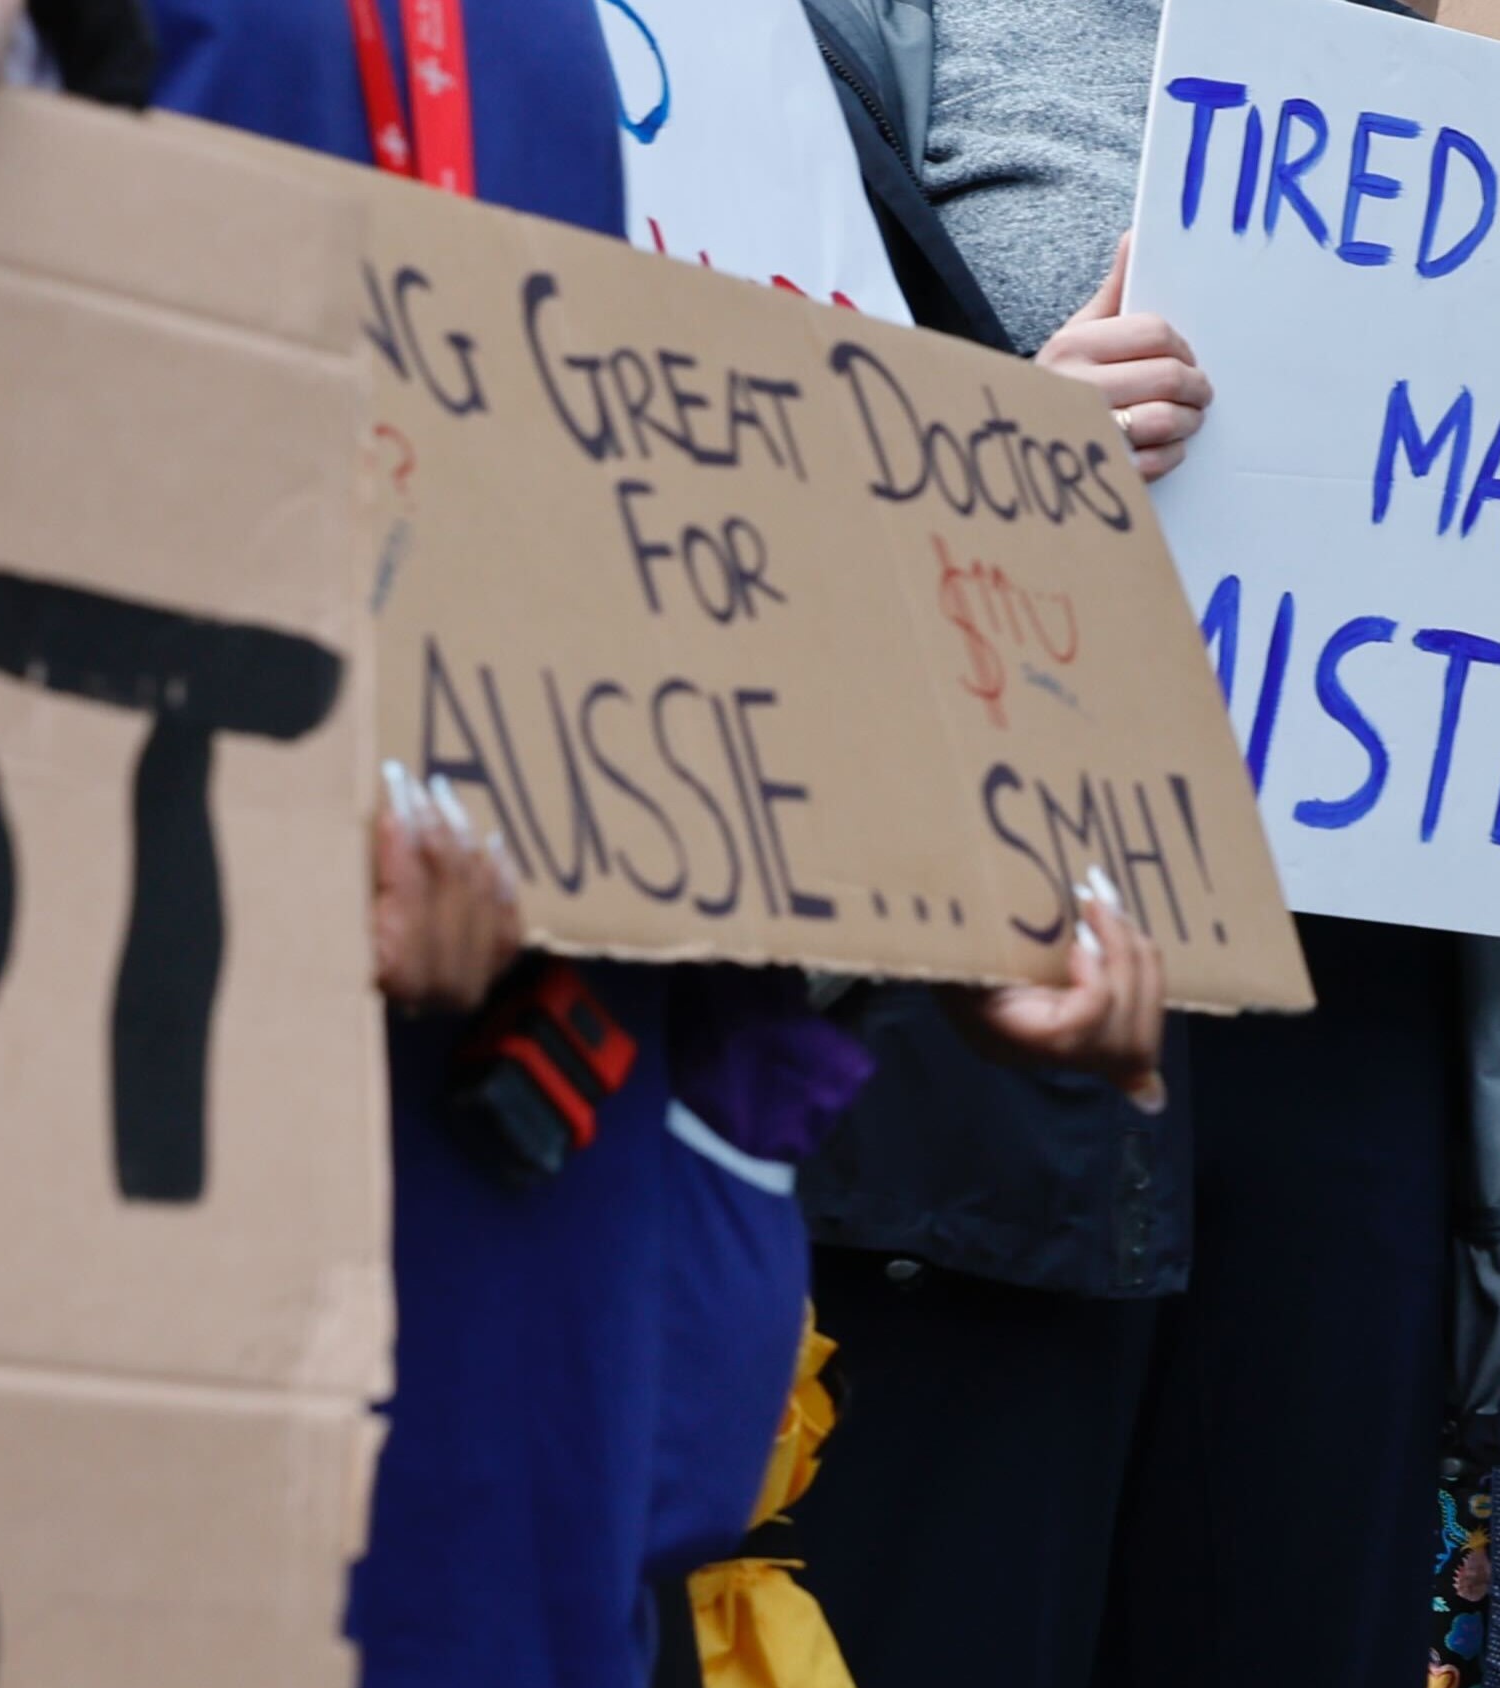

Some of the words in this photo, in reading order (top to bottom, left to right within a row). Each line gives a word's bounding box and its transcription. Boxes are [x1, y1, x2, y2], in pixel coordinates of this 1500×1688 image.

[1165, 76, 1500, 278] TIRED
[521, 271, 809, 483] GREAT
[614, 480, 788, 626] FOR
